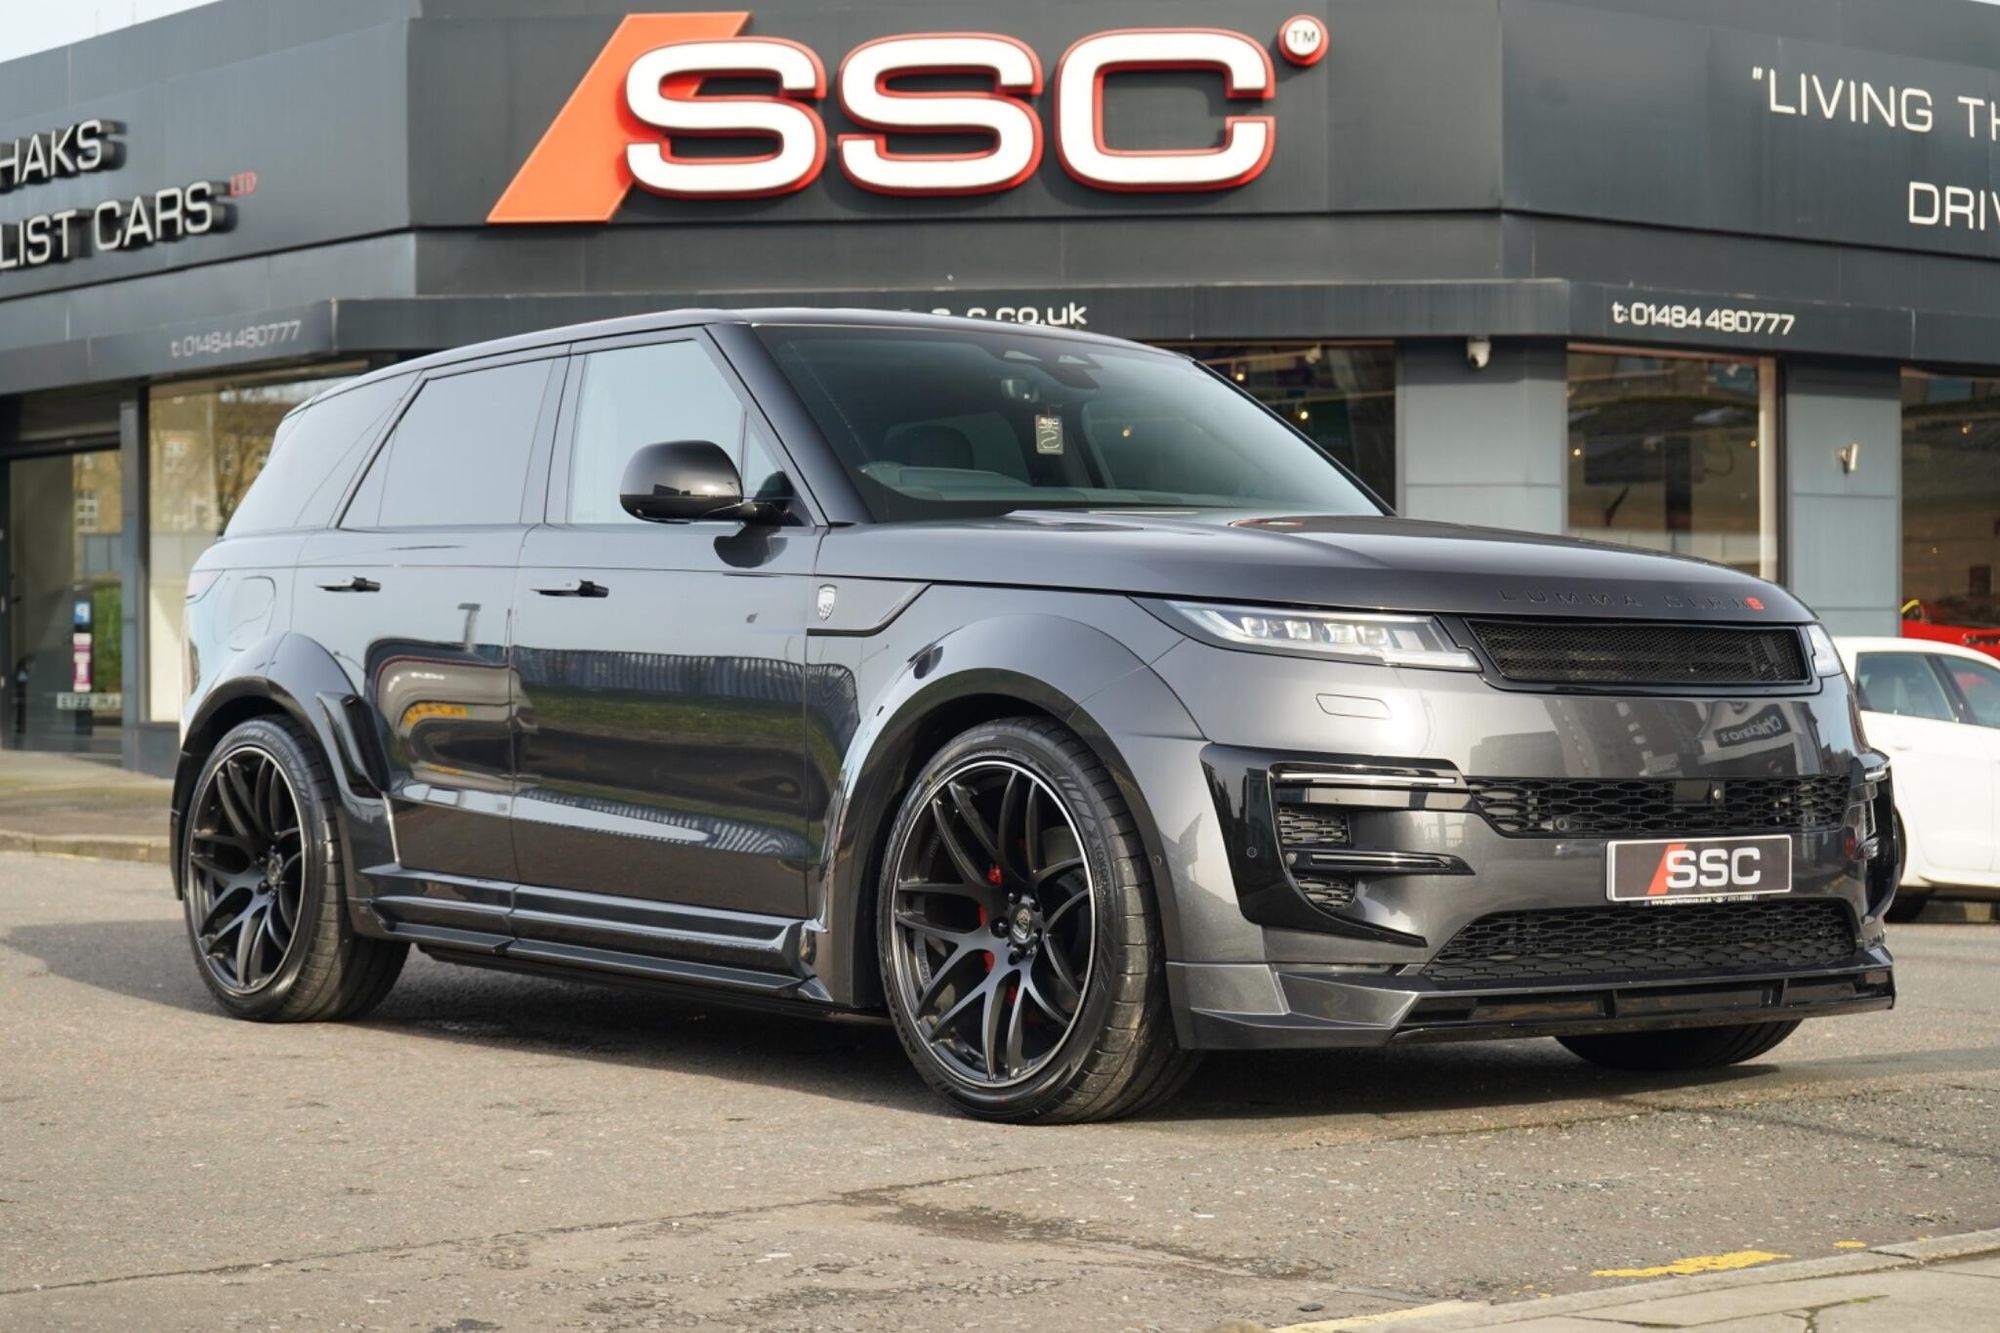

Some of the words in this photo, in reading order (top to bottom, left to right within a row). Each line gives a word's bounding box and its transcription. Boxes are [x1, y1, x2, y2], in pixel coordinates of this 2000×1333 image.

[1291, 29, 1317, 44] TM
[624, 29, 1275, 196] SSC
[1752, 66, 1934, 133] "LIVING
[0, 210, 77, 269] LIST
[94, 179, 213, 251] CARS
[229, 171, 258, 197] LTD
[1908, 180, 2000, 231] DRI
[1665, 847, 1761, 889] SSC
